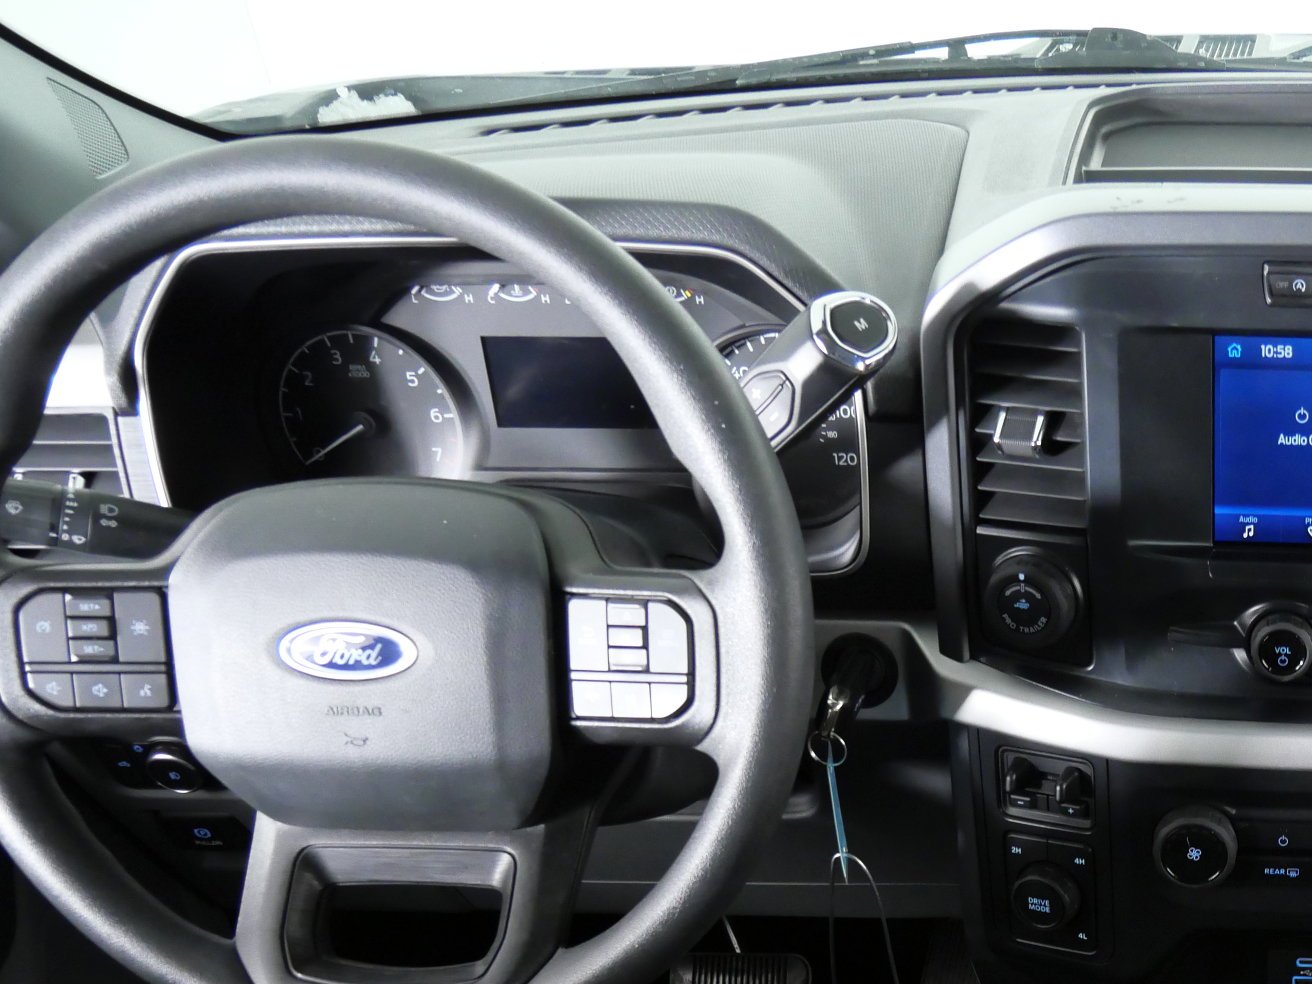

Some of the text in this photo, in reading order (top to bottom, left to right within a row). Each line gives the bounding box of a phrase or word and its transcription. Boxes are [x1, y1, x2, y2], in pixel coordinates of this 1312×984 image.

[1275, 281, 1289, 289] OFF
[464, 294, 474, 304] H
[540, 294, 551, 304] H
[695, 295, 704, 305] H
[853, 317, 869, 332] M
[1260, 344, 1293, 358] 10:58
[330, 350, 342, 365] 3
[369, 350, 382, 365] 4
[302, 371, 314, 386] 2
[405, 372, 418, 387] 5
[430, 408, 443, 423] 6
[1277, 433, 1308, 446] Audio
[431, 447, 442, 462] 7
[832, 452, 858, 466] 120
[1238, 515, 1258, 523] Audio
[1002, 613, 1048, 634] PRO TRAILER
[313, 632, 383, 666] Ford
[1274, 646, 1291, 655] VOL
[325, 705, 383, 717] AIRBAG
[1011, 846, 1022, 855] 2H
[1073, 857, 1086, 865] 4H
[1027, 896, 1050, 907] DRIVE
[1028, 903, 1051, 913] MODE
[1077, 932, 1088, 940] 4L
